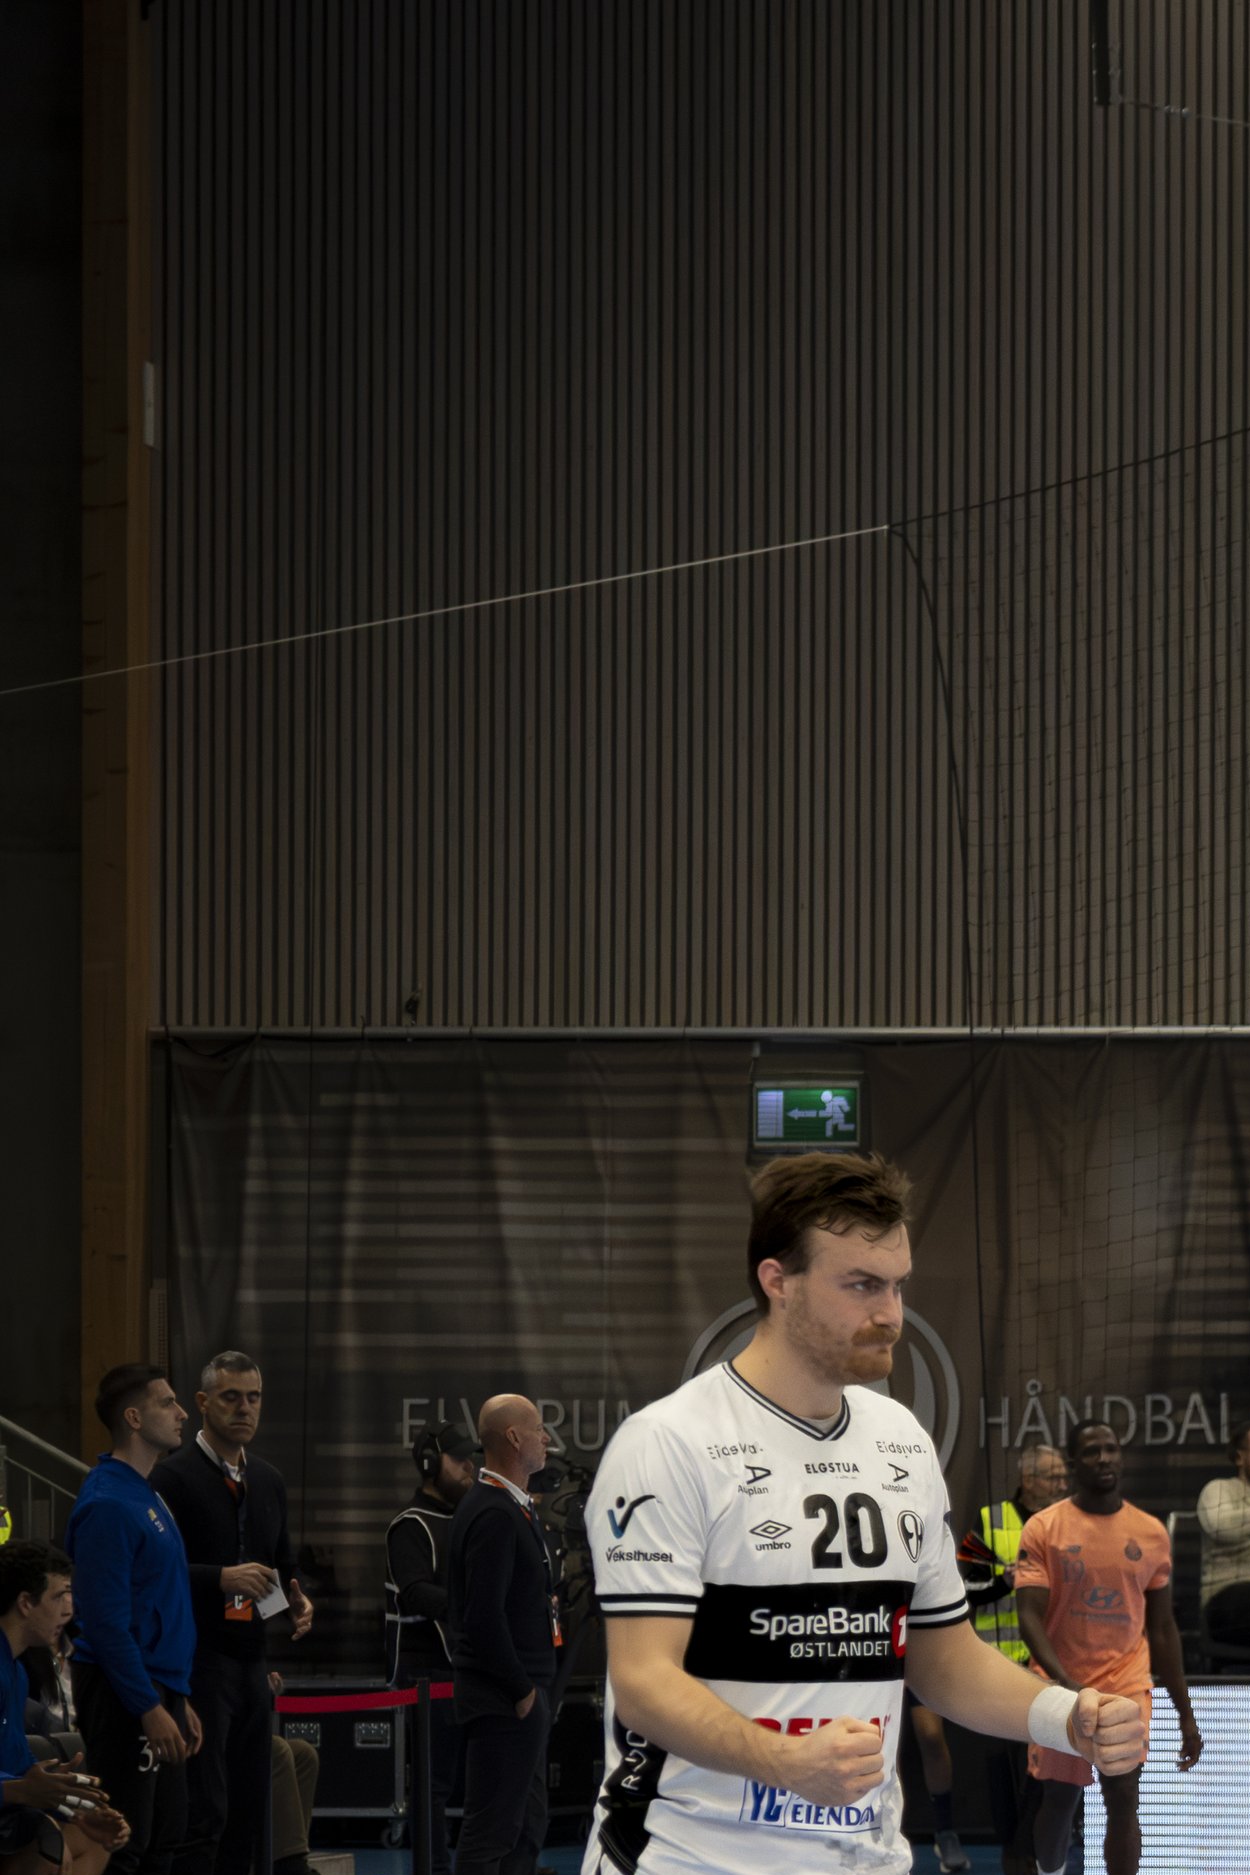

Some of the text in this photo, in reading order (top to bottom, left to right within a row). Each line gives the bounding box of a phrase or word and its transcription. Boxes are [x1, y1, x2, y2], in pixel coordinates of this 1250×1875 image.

[805, 1462, 860, 1475] ELGSTUA
[803, 1492, 888, 1570] 20
[755, 1541, 791, 1551] umbro
[750, 1605, 891, 1640] SpareBank
[790, 1641, 889, 1658] ØSTLANDET
